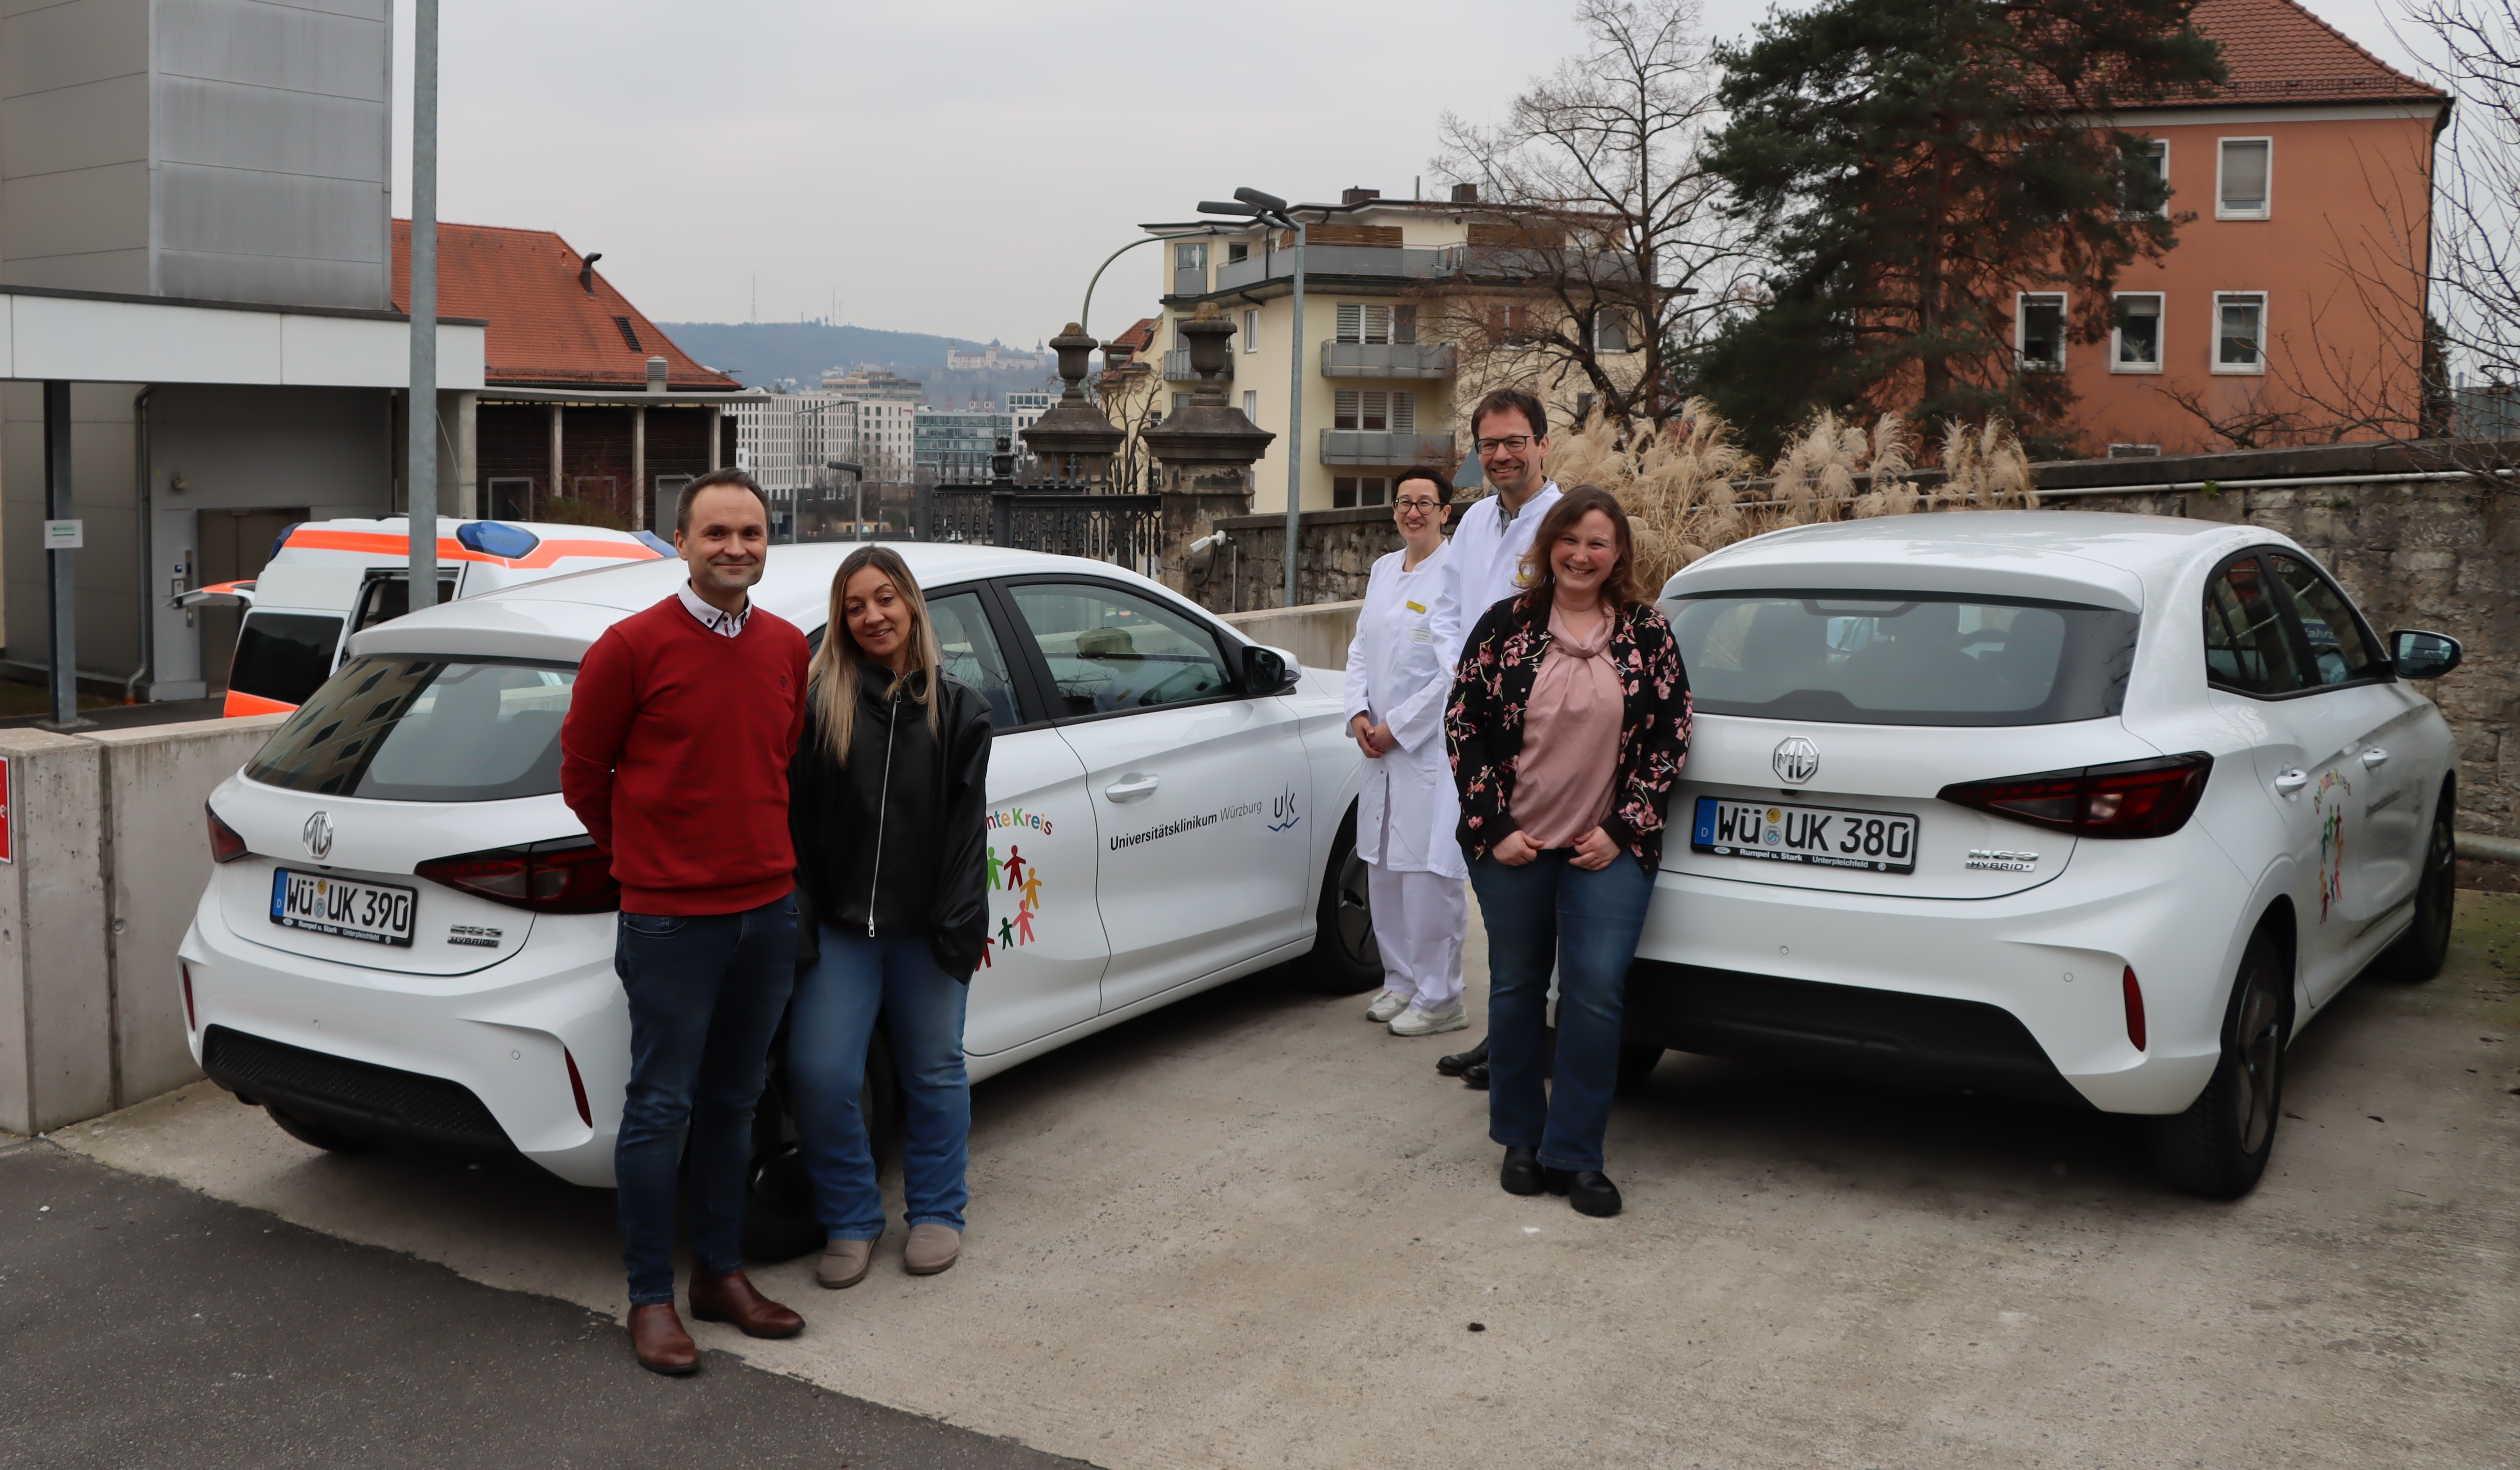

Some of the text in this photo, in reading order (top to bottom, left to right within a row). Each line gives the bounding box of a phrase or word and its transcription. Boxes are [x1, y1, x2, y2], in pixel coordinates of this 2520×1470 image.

[1777, 740, 1815, 779] MG
[1110, 801, 1262, 851] Universitätsklinikum Würzburg
[1701, 827, 1708, 838] D
[1718, 805, 1911, 858] WÜ UK 380
[305, 814, 331, 855] MG
[1740, 849, 1770, 858] Rumpel
[1781, 852, 1803, 862] Stark
[1968, 849, 2040, 861] MG3
[1812, 856, 1869, 868] Unterpleichfeld
[276, 899, 281, 908] D
[286, 877, 409, 932] WÜ UK 390
[298, 920, 318, 931] Rumpel
[324, 925, 337, 934] Stark
[343, 929, 380, 941] Unterpleichfeld
